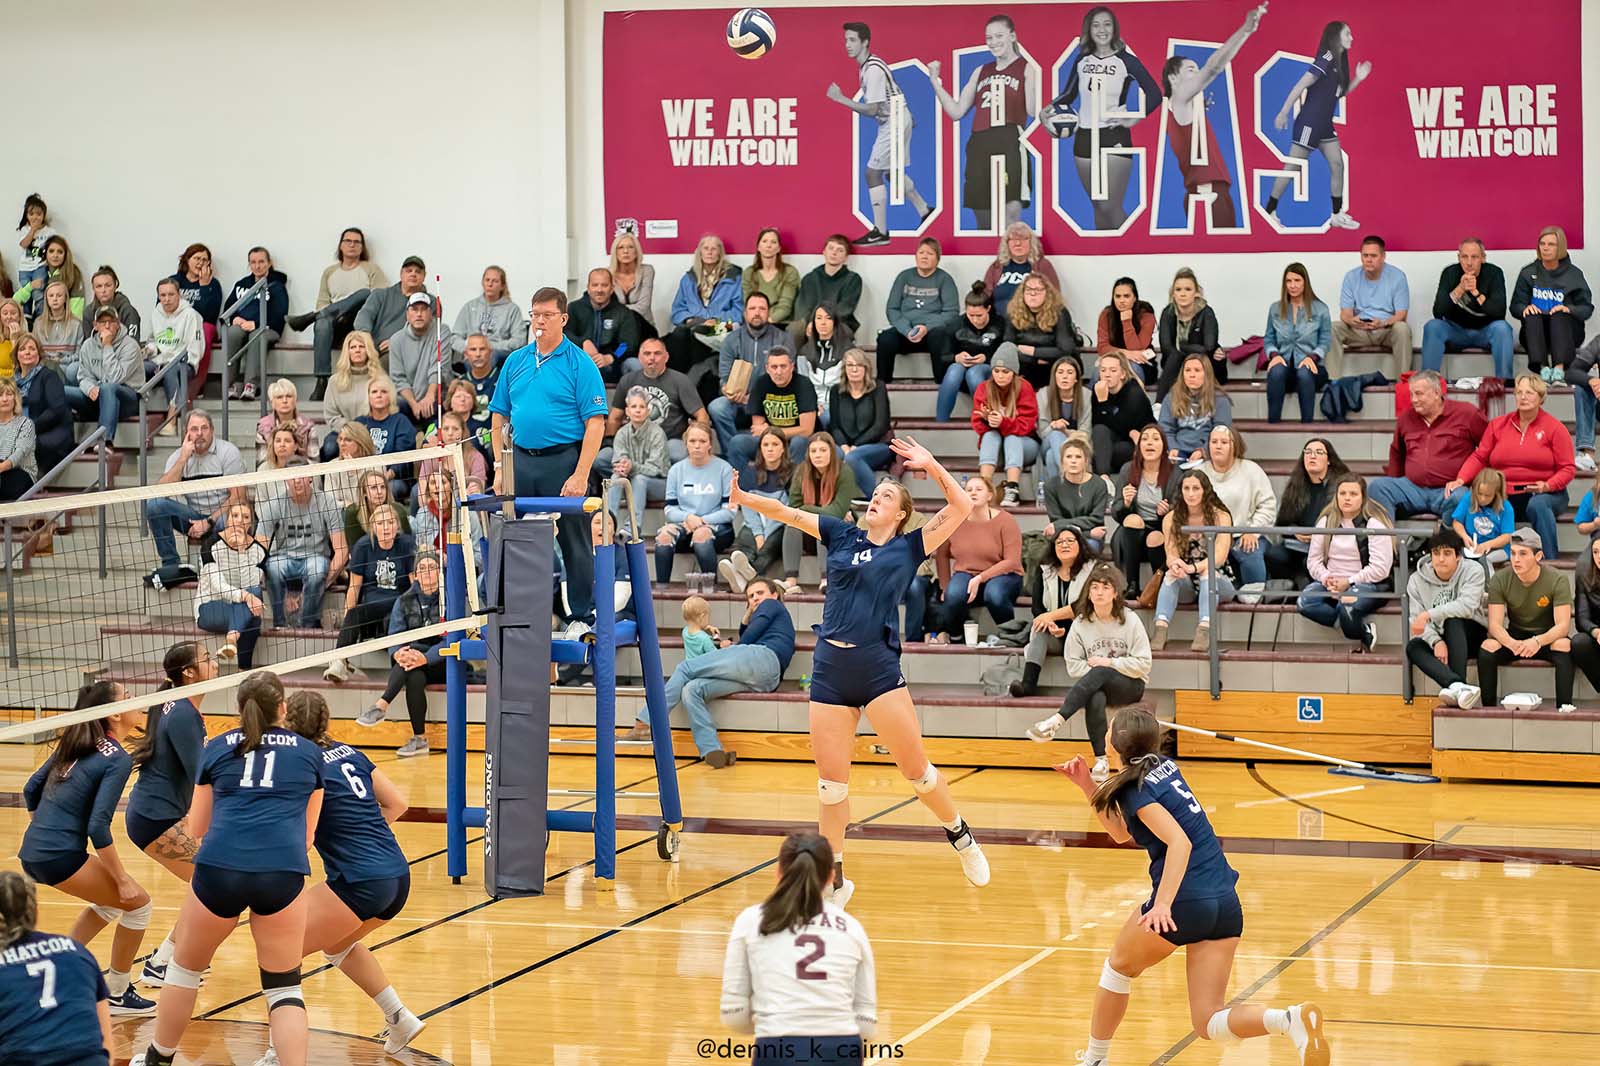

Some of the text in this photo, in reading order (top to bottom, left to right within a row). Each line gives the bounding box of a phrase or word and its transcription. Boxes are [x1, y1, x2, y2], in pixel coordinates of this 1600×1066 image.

[661, 98, 798, 138] WE ARE
[1406, 84, 1557, 128] WE ARE
[669, 139, 798, 167] WHATCOM
[853, 37, 1349, 236] ORCAS
[1415, 127, 1558, 158] WHATCOM
[763, 399, 799, 420] STATE
[683, 484, 714, 495] FILA
[851, 549, 872, 565] 14
[239, 750, 276, 788] 11
[341, 762, 367, 799] 6
[1170, 779, 1201, 813] 5
[795, 934, 828, 980] 2
[25, 959, 58, 1008] 7
